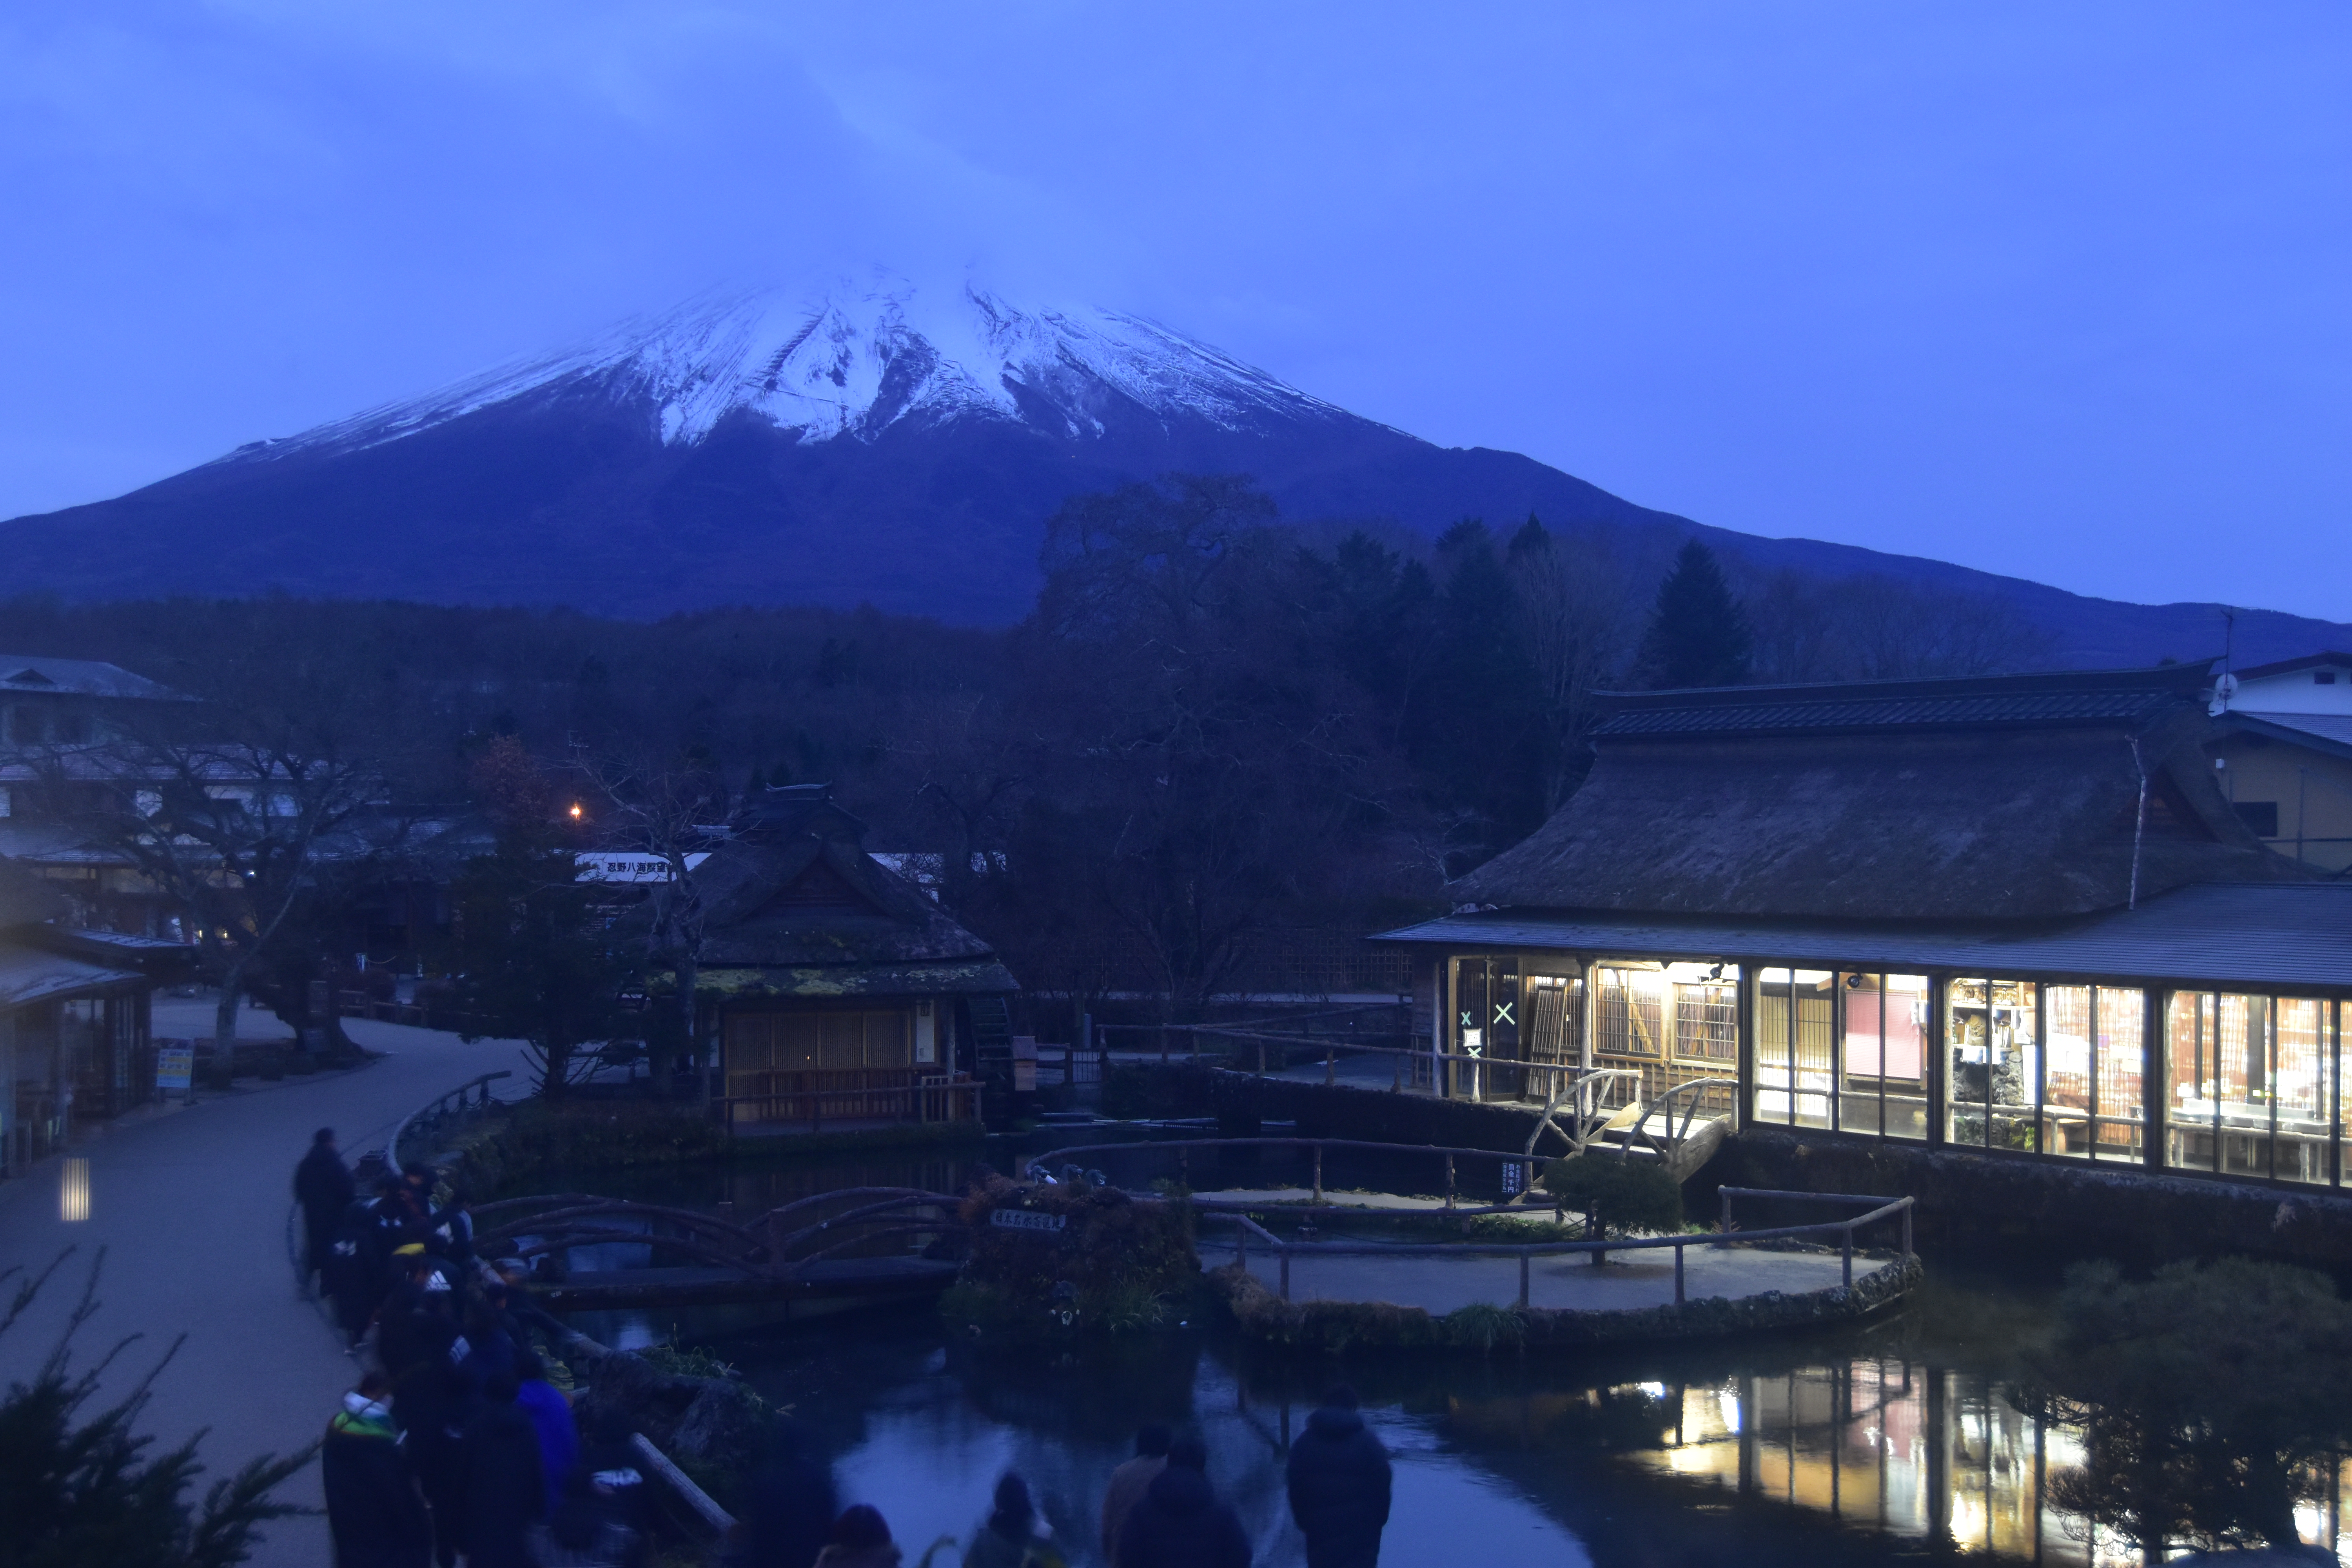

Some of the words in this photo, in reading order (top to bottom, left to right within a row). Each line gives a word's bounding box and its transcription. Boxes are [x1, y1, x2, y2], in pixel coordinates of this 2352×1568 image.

[608, 862, 675, 872] 忍野八海展望
